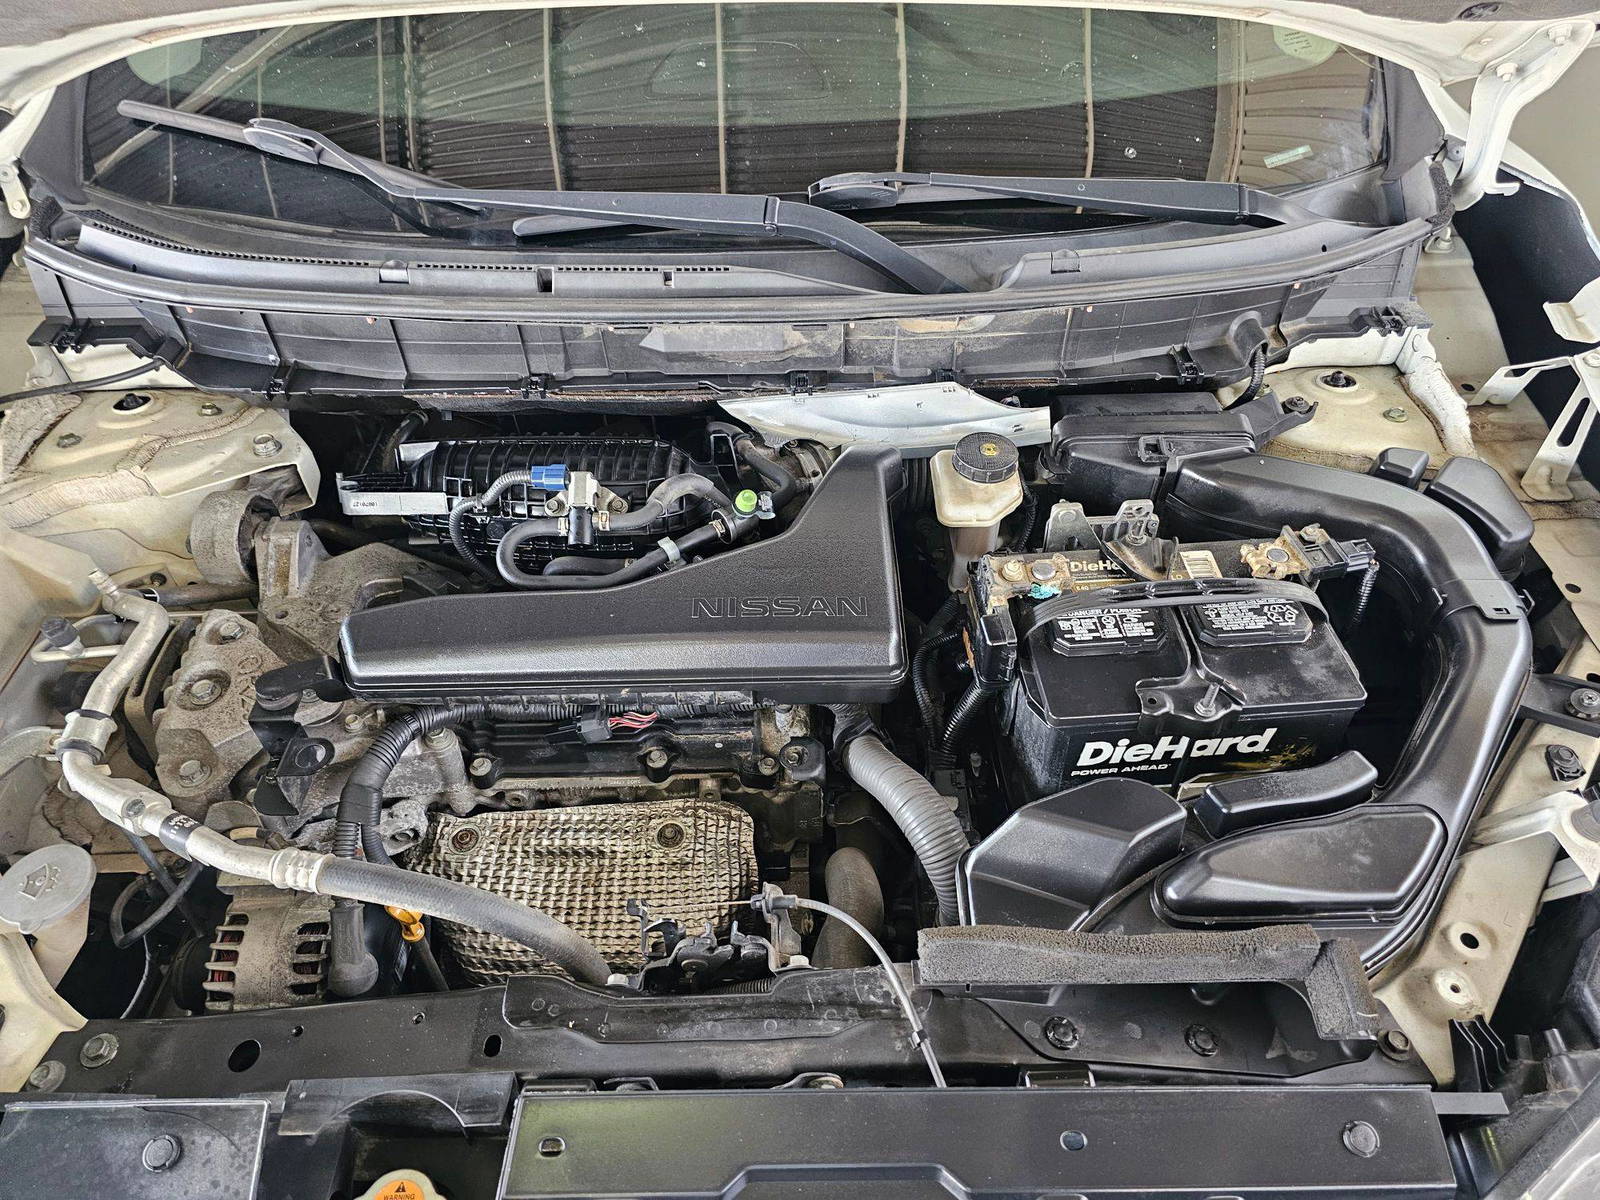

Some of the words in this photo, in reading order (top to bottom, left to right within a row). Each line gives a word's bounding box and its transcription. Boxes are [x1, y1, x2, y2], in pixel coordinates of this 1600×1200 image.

[1070, 560, 1119, 572] DieHa
[691, 596, 868, 618] NISSAN
[1076, 727, 1277, 767] DieHard
[1070, 767, 1118, 777] POWER
[1121, 763, 1168, 773] AHEAD
